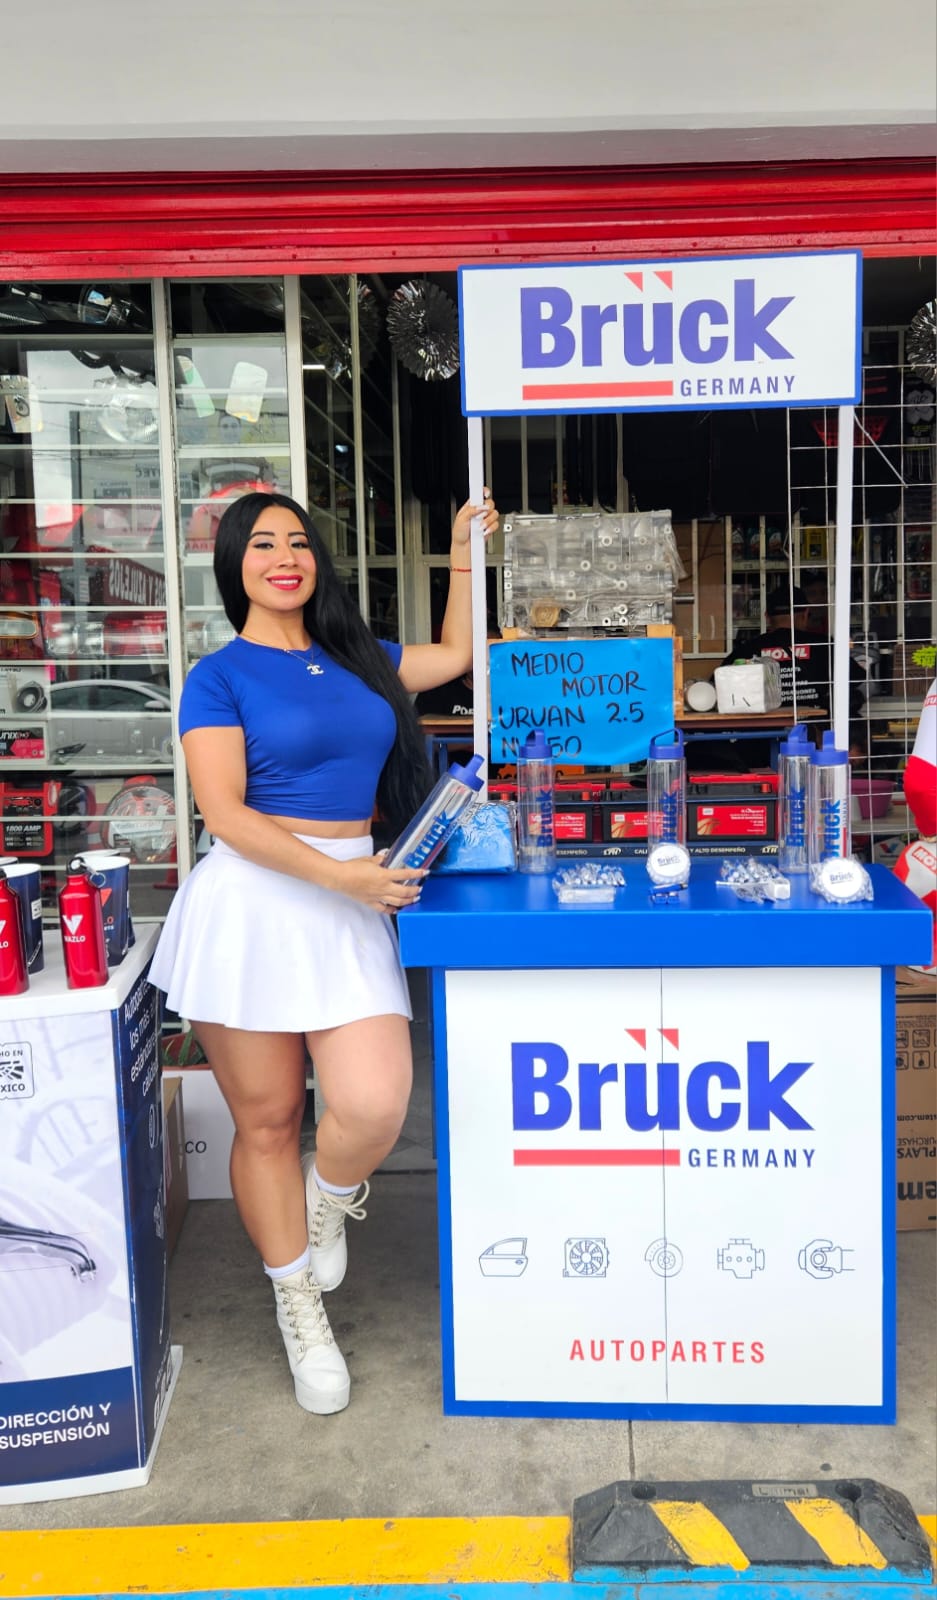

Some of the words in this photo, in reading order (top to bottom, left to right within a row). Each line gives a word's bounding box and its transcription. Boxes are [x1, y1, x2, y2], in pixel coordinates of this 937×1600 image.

[520, 270, 796, 369] Brück
[680, 375, 796, 397] GERMANY
[511, 651, 584, 677] MEDIO
[562, 670, 648, 699] MOTOR
[606, 701, 645, 723] 2.5
[501, 735, 582, 759] N50
[511, 1028, 815, 1132] Brück
[688, 1148, 816, 1168] GERMANY
[569, 1339, 766, 1364] AUTOPARTES
[0, 1404, 94, 1430] DIRECCIÓN
[99, 1401, 111, 1416] Y
[0, 1421, 111, 1450] SUSPENSIÓN
